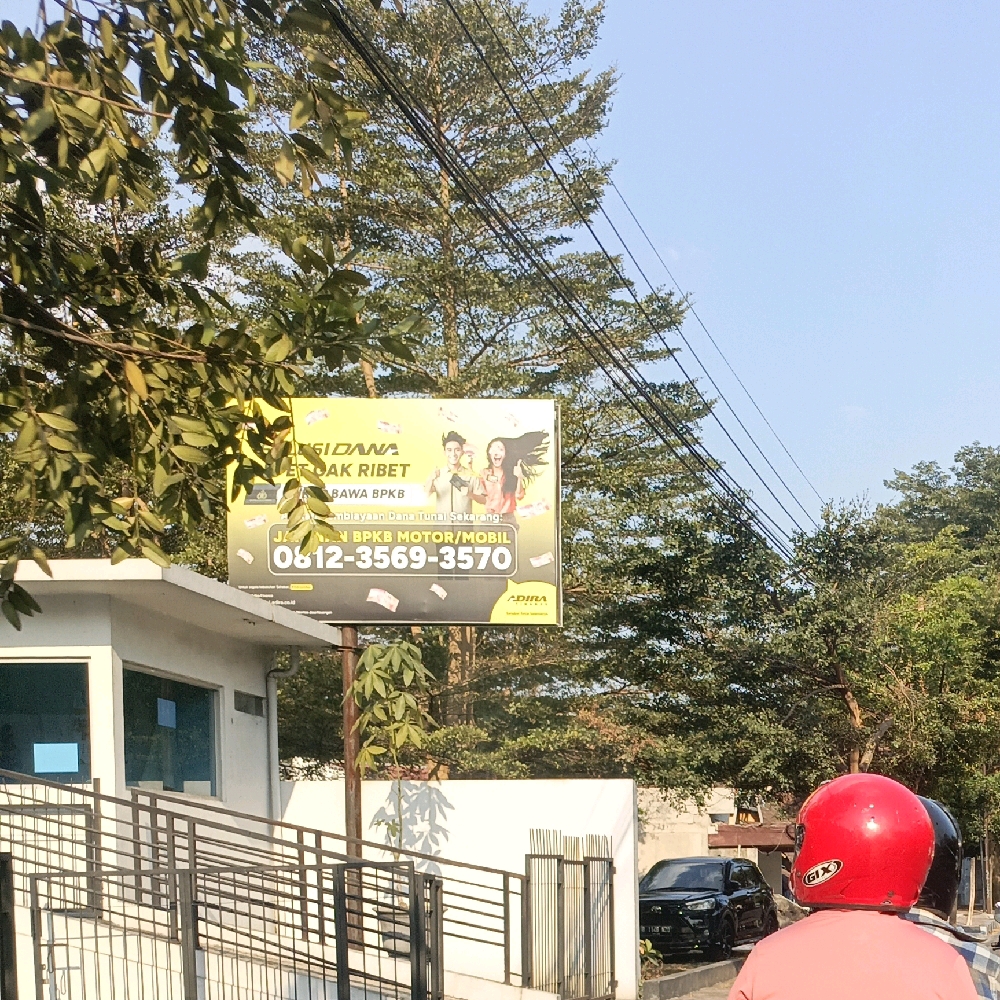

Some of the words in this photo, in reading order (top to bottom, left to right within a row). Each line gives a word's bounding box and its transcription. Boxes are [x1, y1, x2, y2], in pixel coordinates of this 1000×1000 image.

[358, 463, 411, 478] RIBET
[333, 488, 368, 499] BAWA
[372, 488, 406, 499] BPKB
[388, 511, 415, 521] Dana
[419, 511, 447, 521] Tunai
[449, 511, 504, 523] Sekarang:
[352, 531, 393, 543] BPKB
[397, 531, 512, 544] MOTOR/MOBIL
[273, 545, 513, 570] 0812-3569-3570
